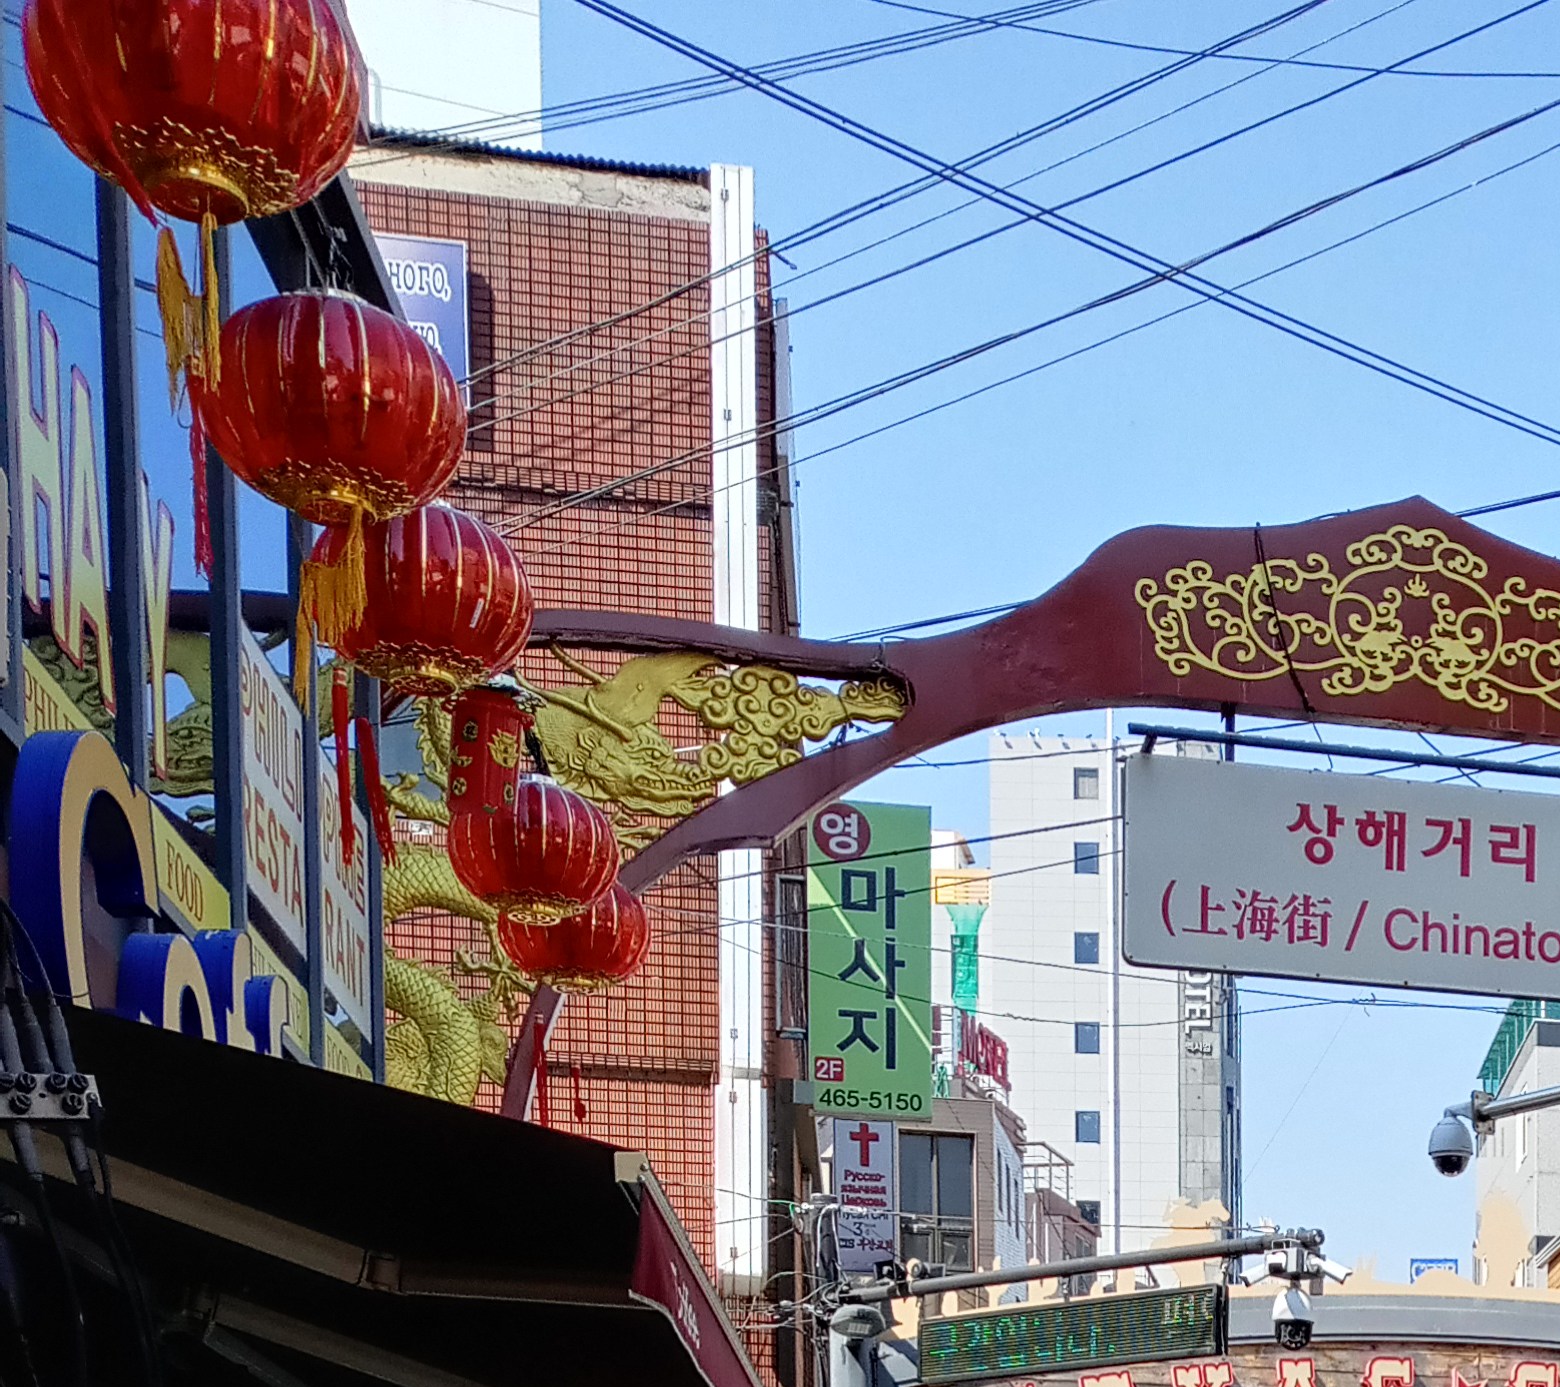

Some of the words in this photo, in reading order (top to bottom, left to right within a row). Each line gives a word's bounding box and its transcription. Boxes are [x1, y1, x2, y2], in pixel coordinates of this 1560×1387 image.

[388, 261, 451, 300] НОГО,
[820, 813, 859, 855] 영
[1287, 803, 1538, 883] 상해거리
[165, 838, 206, 923] FOOD
[243, 776, 365, 1008] RESTARANT
[836, 866, 906, 1070] 마사지
[815, 1058, 843, 1080] 2F
[819, 1088, 923, 1112] 465-5150
